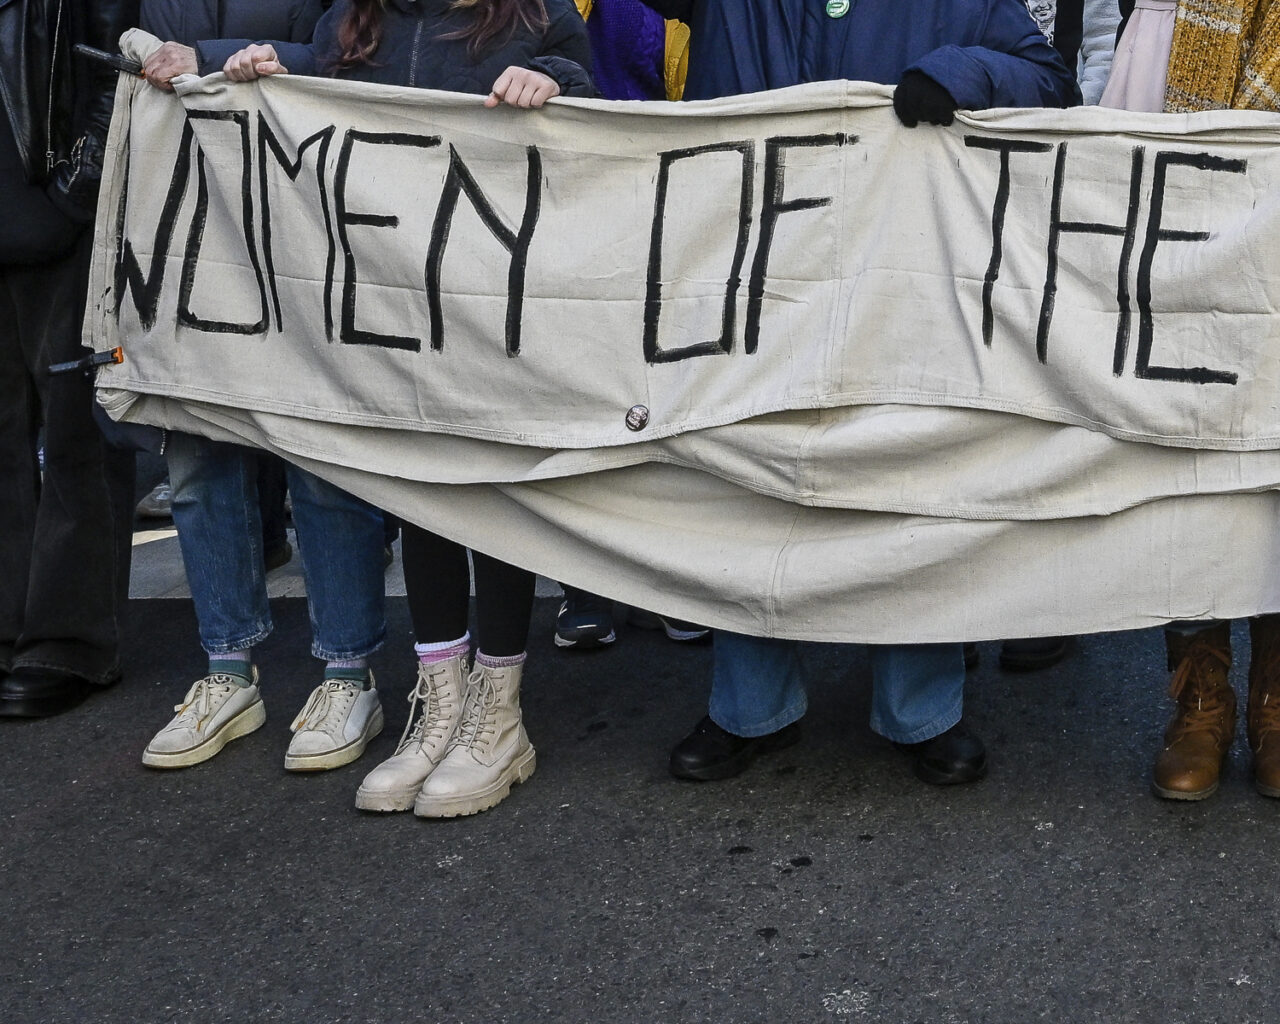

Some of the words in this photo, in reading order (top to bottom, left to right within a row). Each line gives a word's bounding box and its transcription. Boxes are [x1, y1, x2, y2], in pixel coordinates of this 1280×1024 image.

[114, 109, 541, 356] WOMEN
[644, 132, 859, 364] OF
[964, 134, 1246, 383] THE
